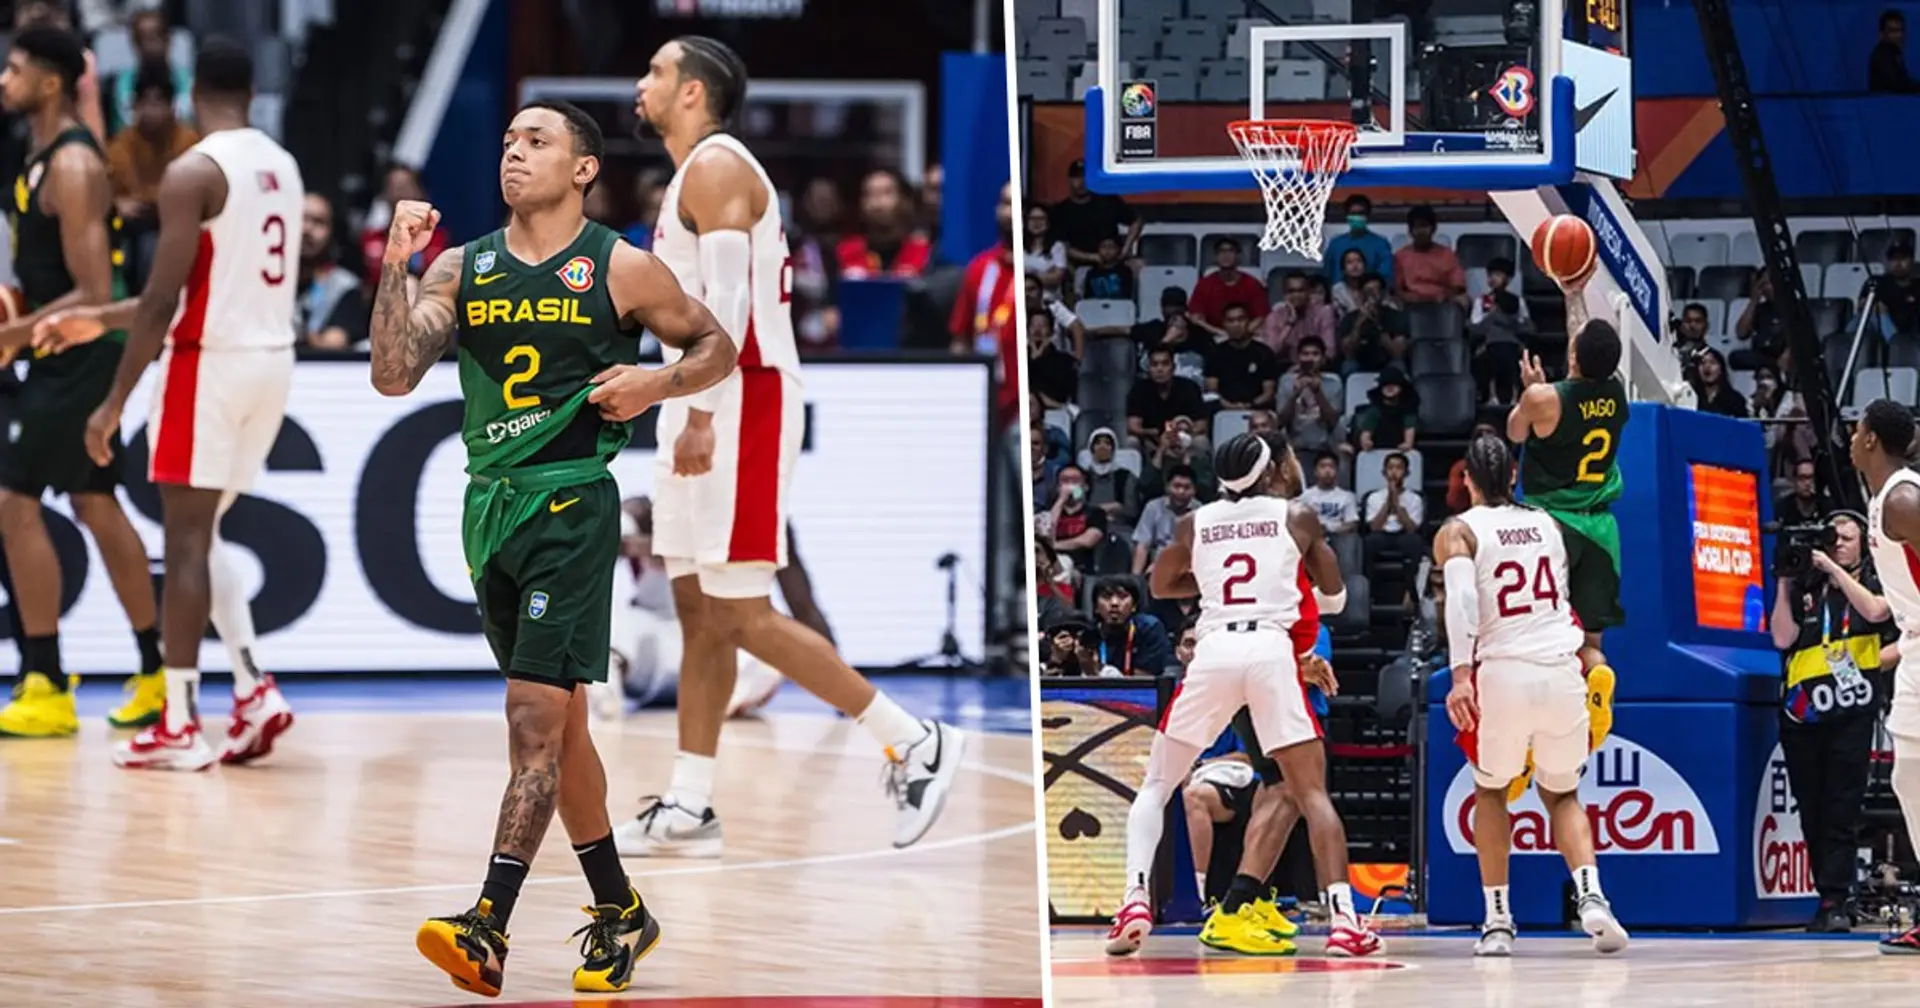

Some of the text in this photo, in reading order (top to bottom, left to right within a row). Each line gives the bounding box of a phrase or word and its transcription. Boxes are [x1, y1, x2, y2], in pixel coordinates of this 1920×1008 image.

[1125, 125, 1151, 140] FIBA
[261, 214, 285, 287] 3
[466, 298, 592, 326] BRASIL
[503, 345, 541, 410] 2
[1578, 398, 1616, 420] YAGO
[1576, 427, 1612, 482] 2
[1496, 526, 1542, 546] BROOKS
[1223, 552, 1257, 605] 2
[1493, 555, 1559, 617] 24
[1812, 678, 1873, 712] 069
